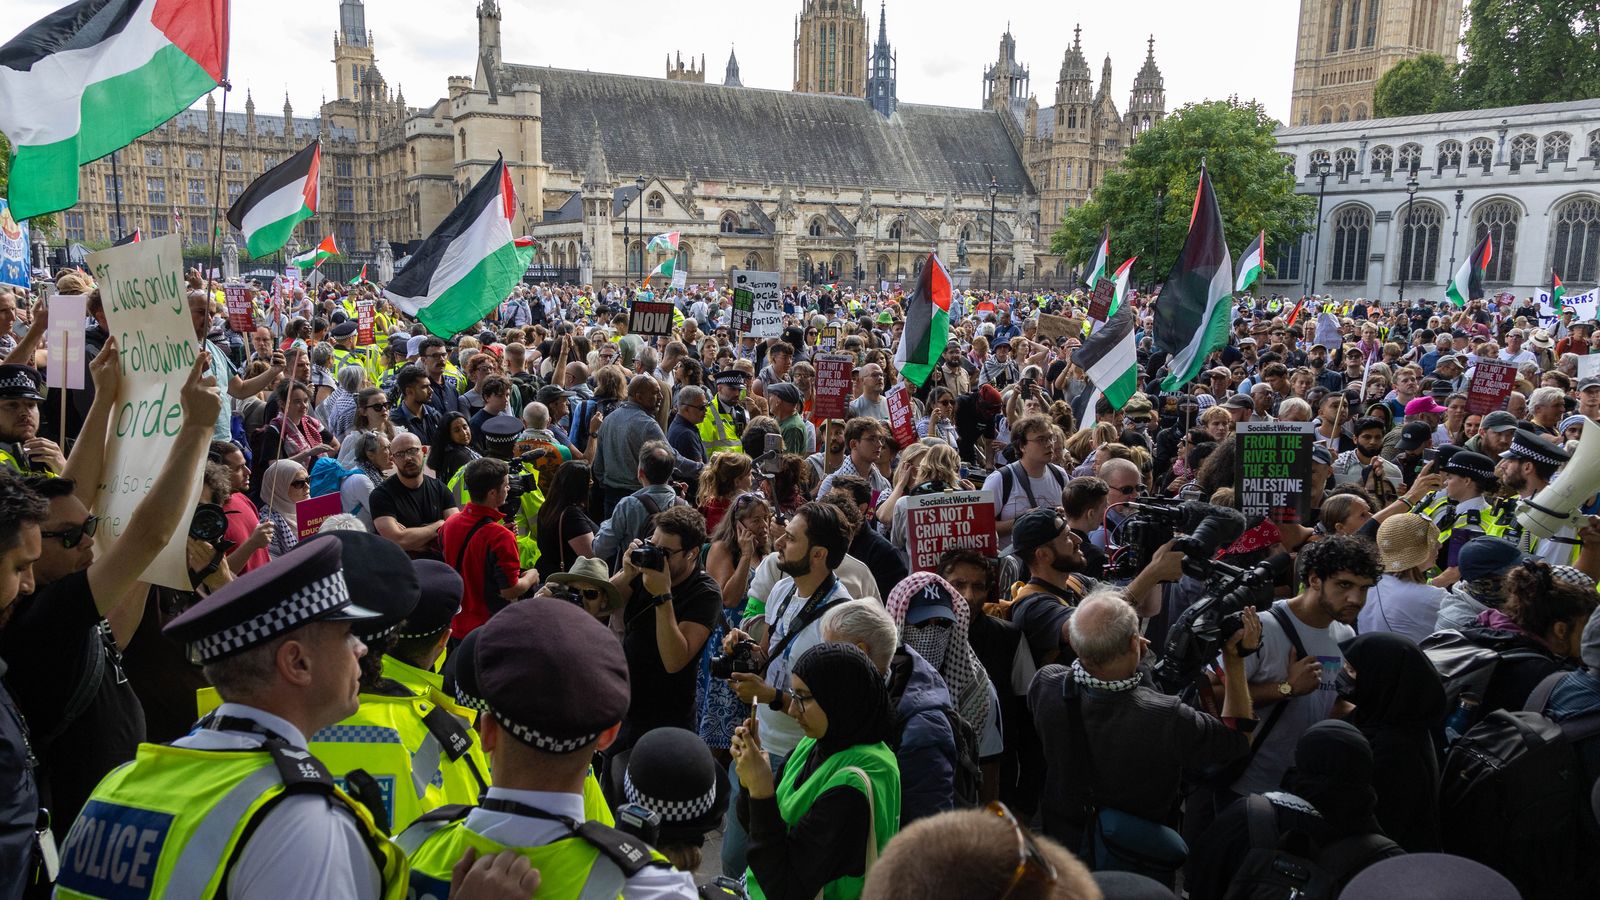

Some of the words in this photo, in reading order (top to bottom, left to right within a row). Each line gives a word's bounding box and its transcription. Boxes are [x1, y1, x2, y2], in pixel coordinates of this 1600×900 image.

[144, 253, 182, 315] only
[757, 299, 779, 312] NOT
[632, 311, 670, 333] NOW
[827, 362, 839, 371] NOT
[840, 362, 844, 371] A
[1489, 365, 1501, 374] NOT
[1502, 367, 1507, 375] A
[834, 370, 841, 379] TO
[1495, 374, 1504, 382] TO
[1471, 385, 1500, 396] GENOCIDE
[1473, 378, 1486, 386] ACT
[1485, 380, 1511, 390] AGAINST
[1247, 424, 1277, 432] Socialist
[1277, 424, 1303, 432] Worker
[1243, 435, 1277, 449] FROM
[1280, 435, 1303, 449] THE
[1243, 449, 1277, 463] RIVER
[1280, 449, 1296, 463] TO
[1243, 463, 1265, 478] THE
[1267, 463, 1290, 478] SEA
[1242, 478, 1303, 493] PALESTINE
[920, 497, 953, 507] Socialist
[952, 494, 981, 504] Worker
[1241, 492, 1270, 506] WILL
[1272, 492, 1287, 506] BE
[913, 508, 937, 525] IT'S
[939, 506, 963, 522] NOT
[966, 506, 975, 520] A
[915, 522, 953, 539] CRIME
[955, 520, 971, 536] TO
[916, 538, 938, 554] ACT
[941, 534, 990, 551] AGAINST
[924, 583, 941, 600] NY
[61, 815, 160, 888] POLICE
